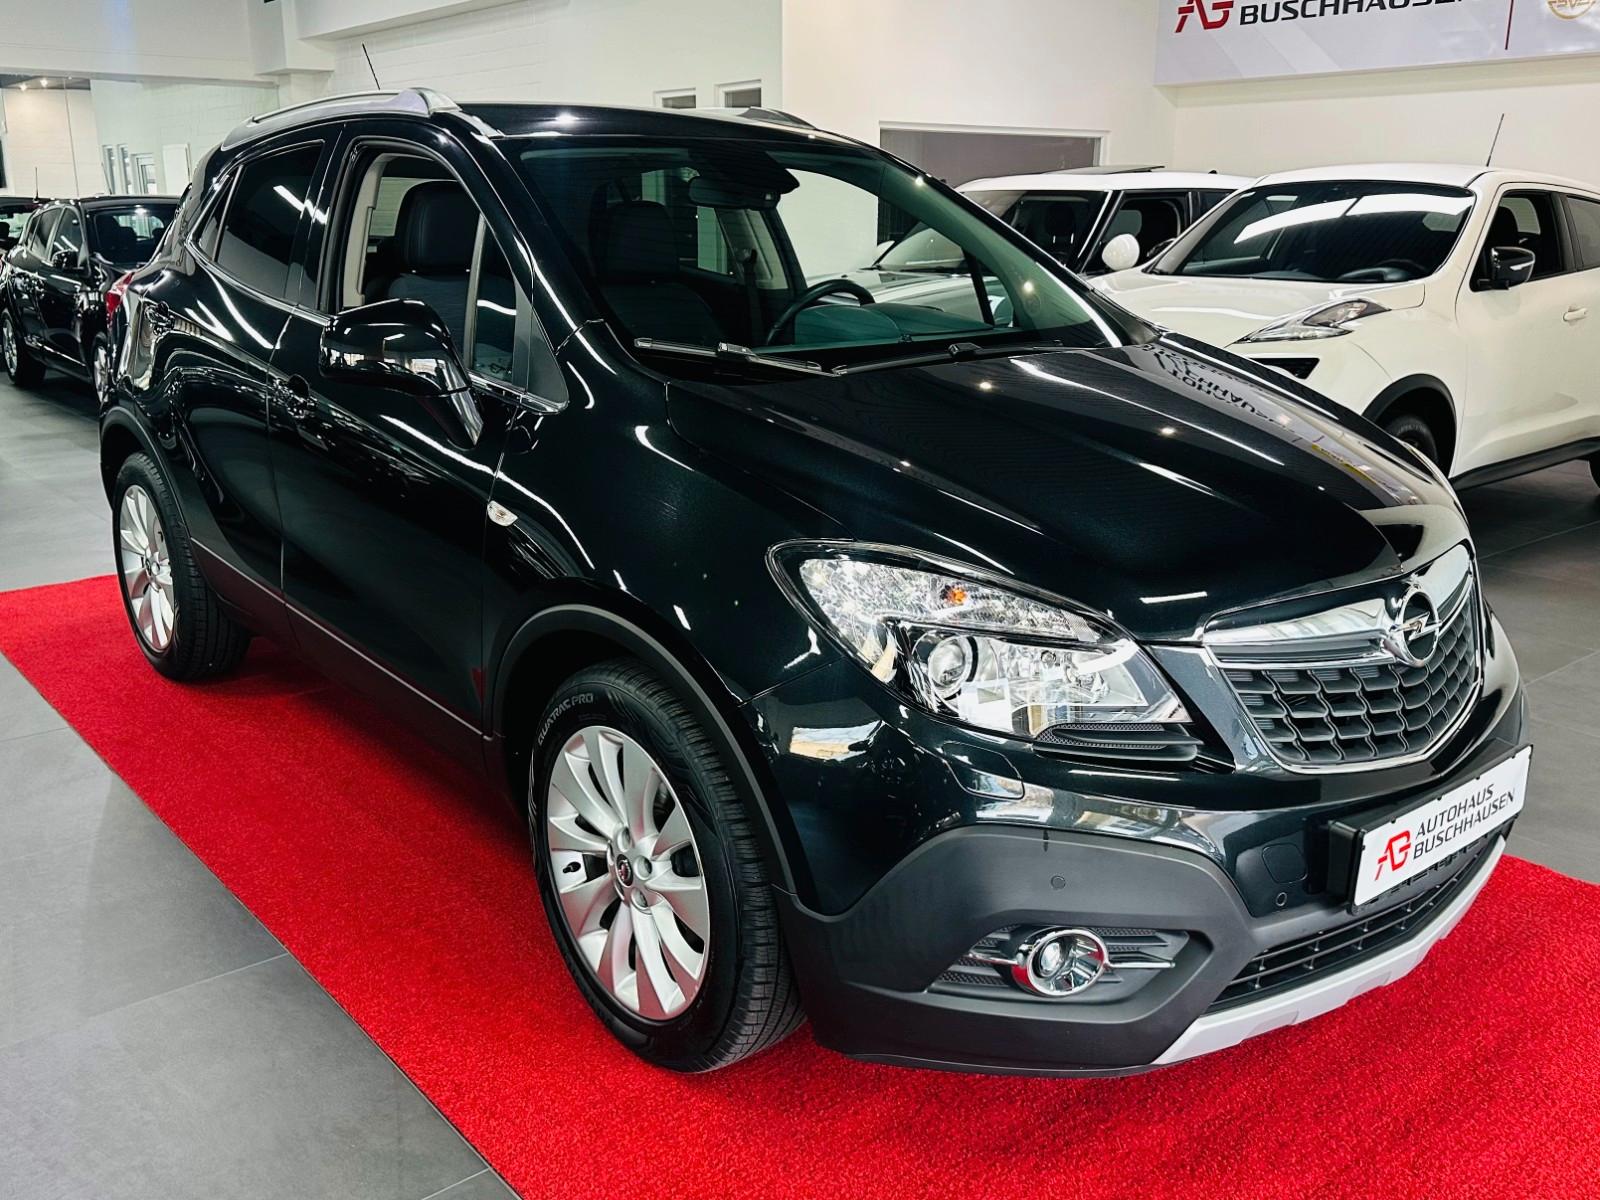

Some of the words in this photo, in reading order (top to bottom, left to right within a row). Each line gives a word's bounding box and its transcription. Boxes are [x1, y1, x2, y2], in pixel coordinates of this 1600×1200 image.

[537, 697, 572, 746] QUATRAC
[570, 692, 595, 707] PRO
[1412, 789, 1515, 860] BUSCHHAUSEN
[1415, 783, 1495, 839] AUTOHAUS
